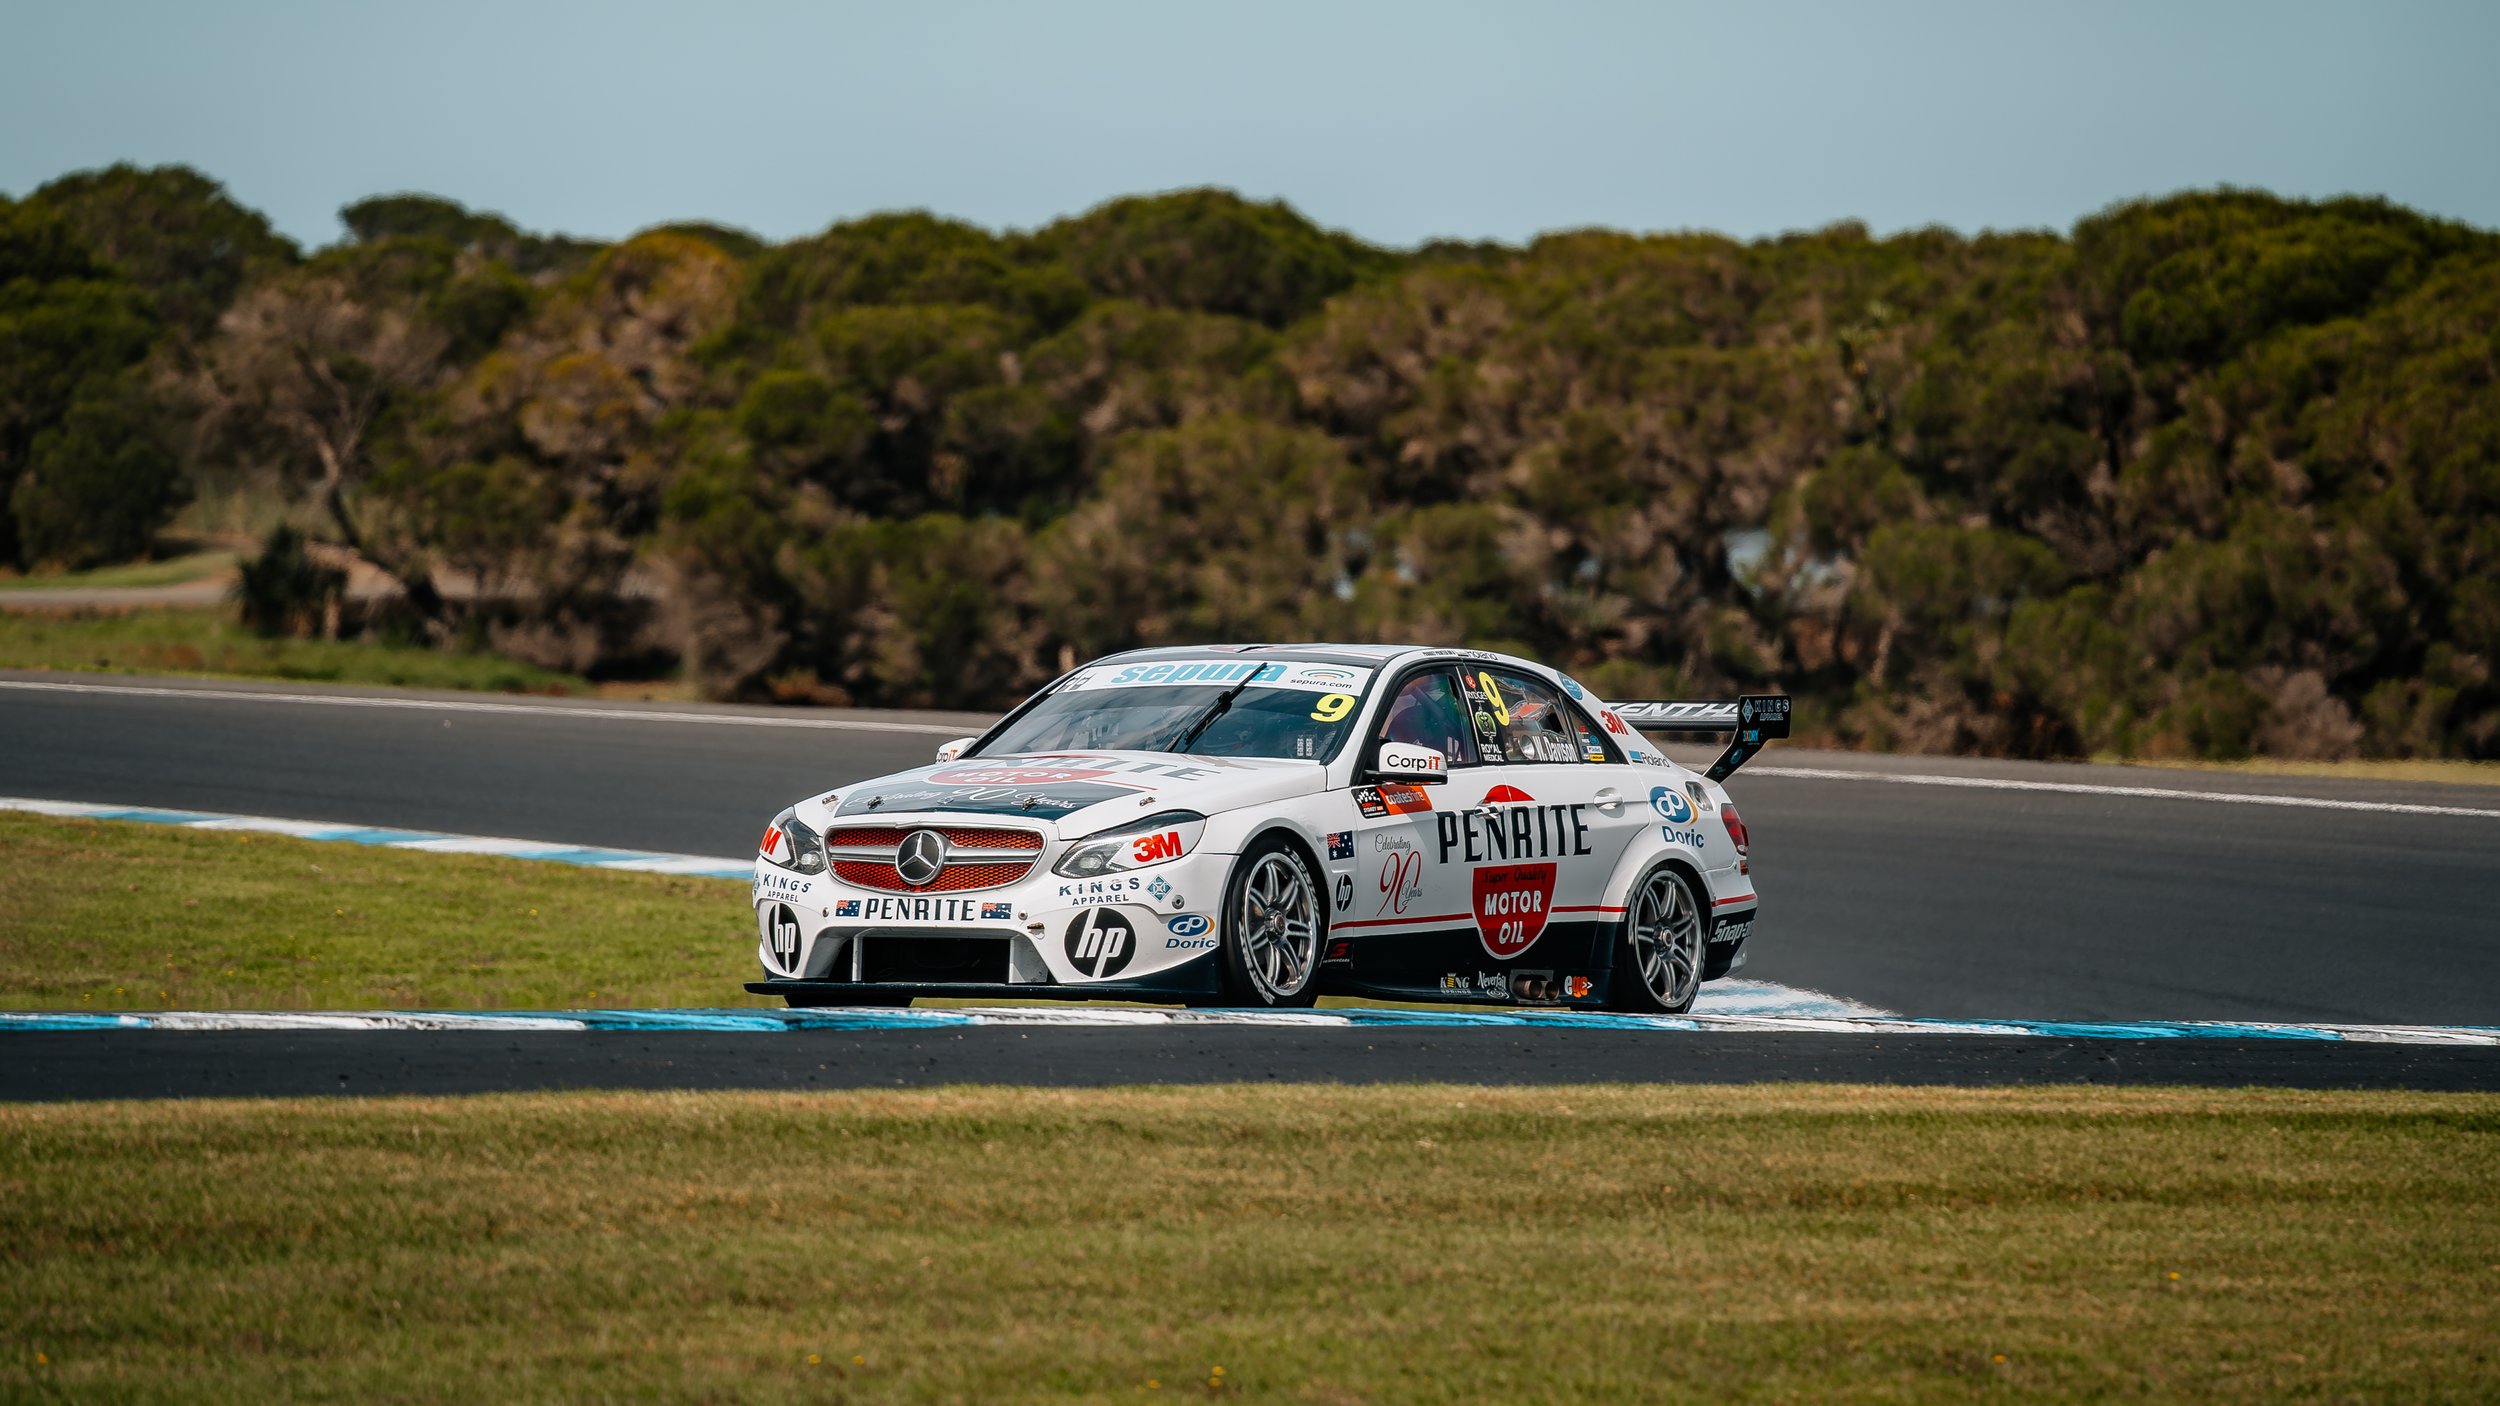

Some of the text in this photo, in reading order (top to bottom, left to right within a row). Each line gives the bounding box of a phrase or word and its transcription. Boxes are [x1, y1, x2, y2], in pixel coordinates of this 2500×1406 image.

[1111, 662, 1288, 684] sepura
[1290, 677, 1353, 690] sepura.com
[1310, 694, 1356, 722] 9
[1478, 671, 1510, 726] 9
[1754, 699, 1790, 713] KINGS
[1600, 710, 1630, 736] 3M
[1480, 743, 1502, 754] ROYAL
[1483, 753, 1505, 762] MEDICAL
[1532, 735, 1578, 762] W. Davison
[1642, 751, 1671, 768] Roland
[950, 770, 1072, 779] MOTOR
[947, 786, 1018, 801] 90
[1436, 803, 1593, 865] PENRITE
[1661, 825, 1705, 849] Doric
[1132, 831, 1183, 863] 3M
[763, 873, 812, 894] KINGS
[1376, 850, 1422, 917] 90
[1482, 865, 1547, 885] Super Quality
[767, 890, 799, 903] APPAREL
[1058, 877, 1141, 897] KINGS
[1337, 873, 1352, 912] hp
[864, 897, 975, 921] PENRITE
[1071, 894, 1130, 906] APPAREL
[1484, 889, 1542, 916] MOTOR
[775, 903, 797, 974] hp
[1074, 907, 1128, 978] hp
[1165, 937, 1216, 949] Doric
[1498, 920, 1525, 945] OIL
[1477, 970, 1507, 990] Neverfail
